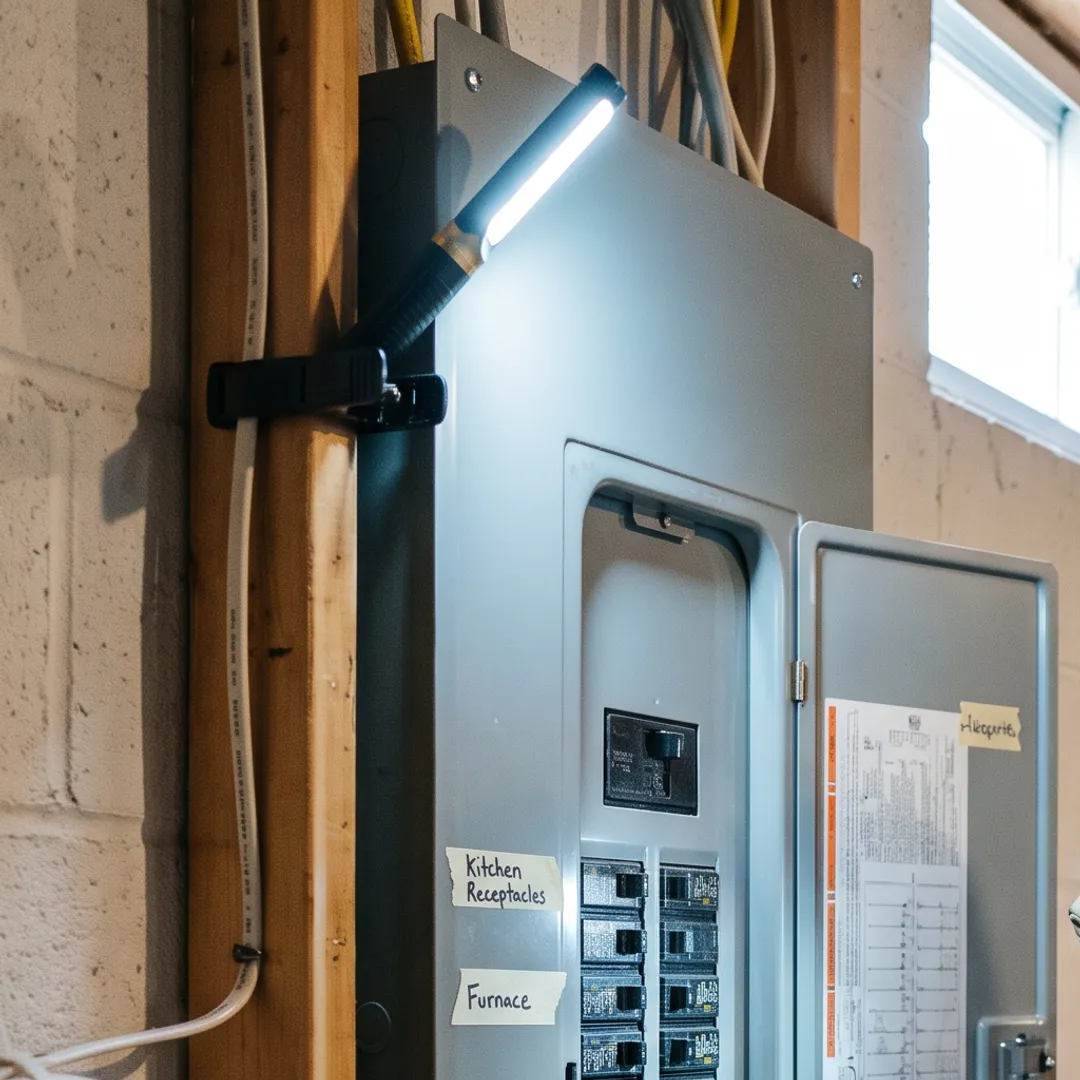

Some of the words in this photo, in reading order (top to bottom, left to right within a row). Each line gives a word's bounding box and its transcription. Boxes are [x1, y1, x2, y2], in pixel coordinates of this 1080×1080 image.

[466, 854, 522, 880] Kitchen
[467, 881, 546, 909] Receptacles
[468, 983, 532, 1010] Furnace
